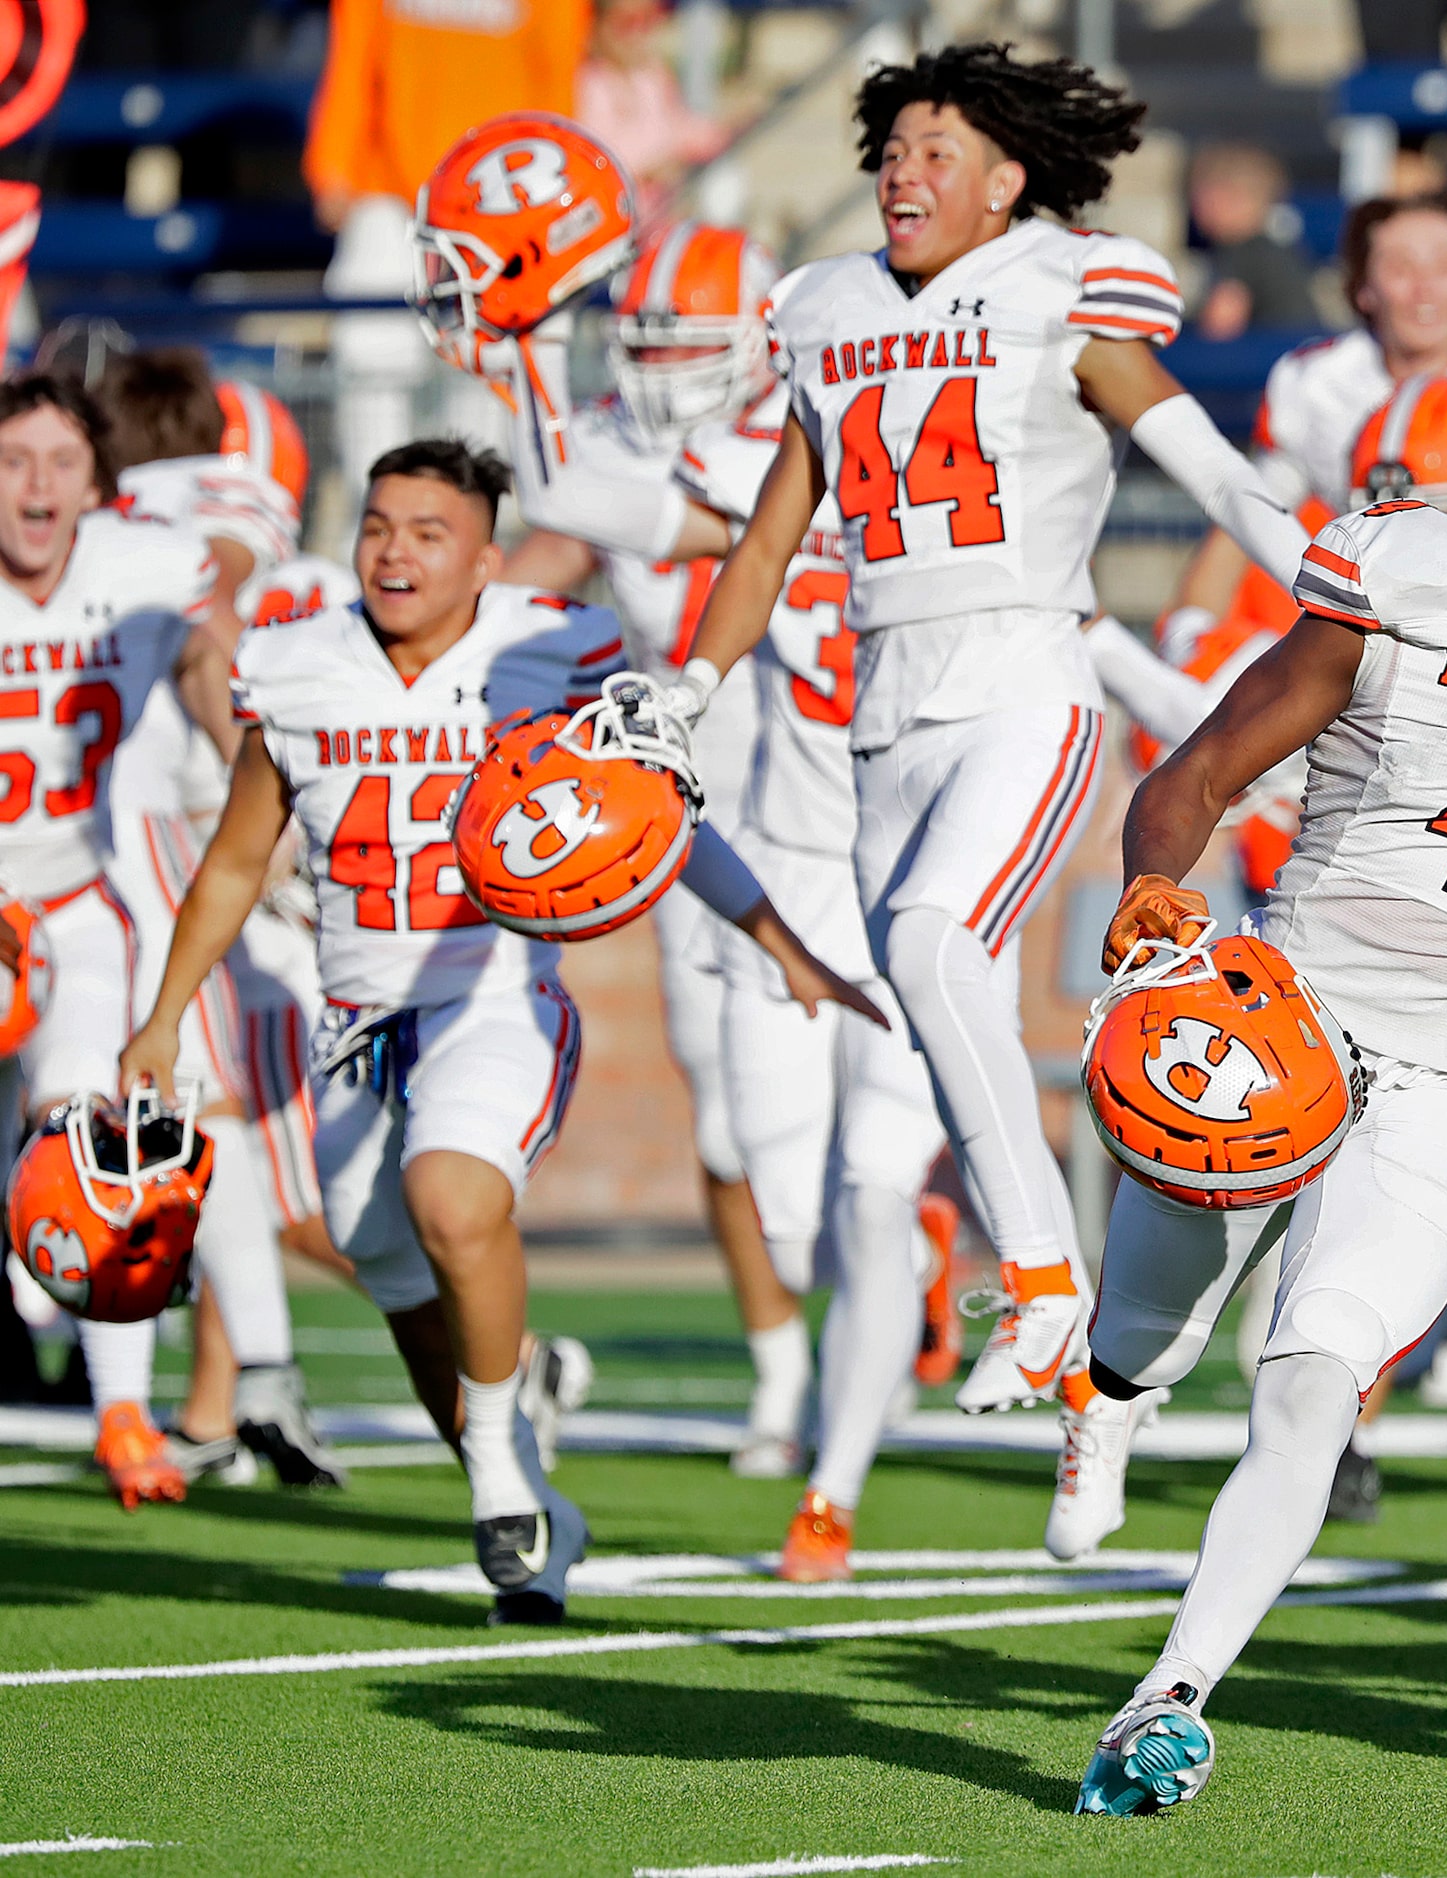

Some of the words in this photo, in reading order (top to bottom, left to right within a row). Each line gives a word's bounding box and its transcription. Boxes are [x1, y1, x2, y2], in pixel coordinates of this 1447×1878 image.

[466, 137, 570, 216] R
[821, 328, 997, 386] ROCKWALL
[837, 375, 1006, 562] 44
[328, 774, 496, 932] 42
[1143, 1016, 1273, 1123] R
